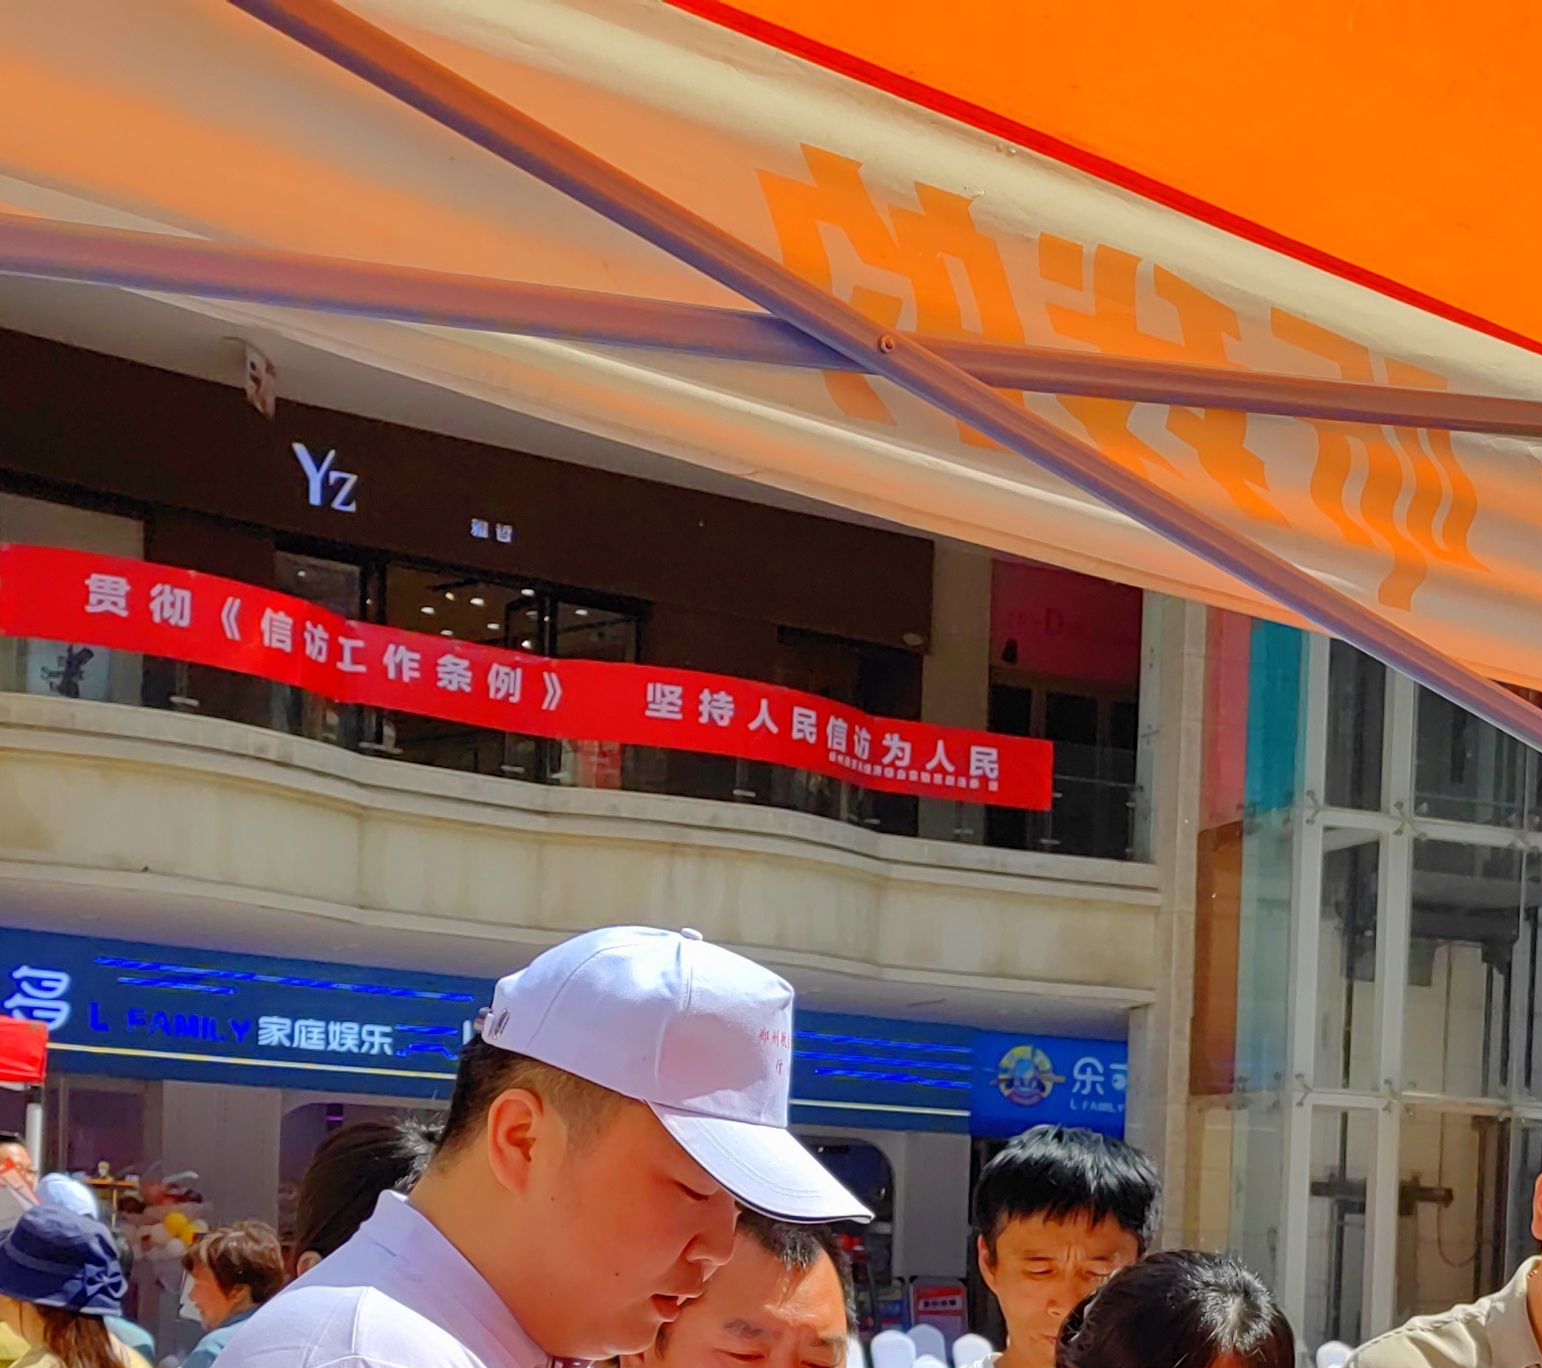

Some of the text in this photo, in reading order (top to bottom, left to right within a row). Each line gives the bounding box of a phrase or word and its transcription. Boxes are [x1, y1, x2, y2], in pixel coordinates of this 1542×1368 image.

[83, 572, 999, 778] 贯彻《信访工作条例》 坚持人民信访为人民
[127, 1007, 249, 1043] FAMILY
[257, 1015, 394, 1056] 家庭娱乐
